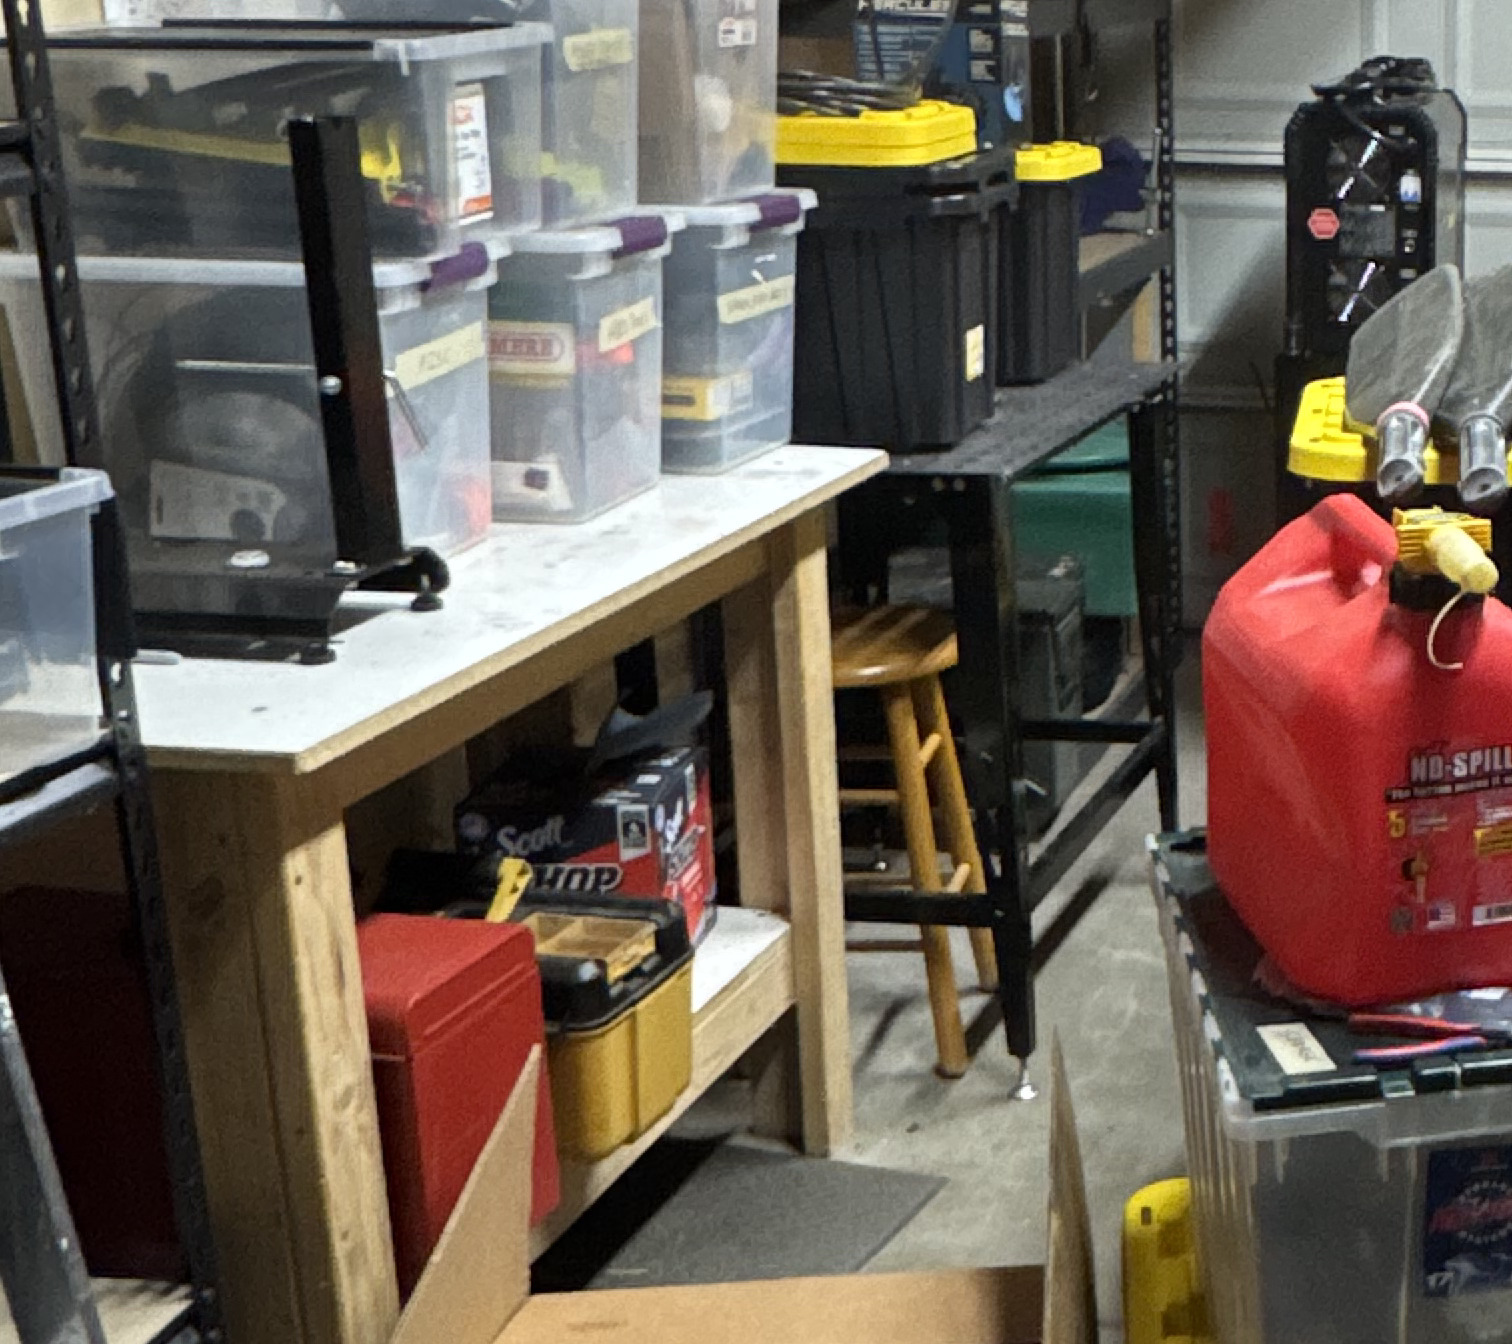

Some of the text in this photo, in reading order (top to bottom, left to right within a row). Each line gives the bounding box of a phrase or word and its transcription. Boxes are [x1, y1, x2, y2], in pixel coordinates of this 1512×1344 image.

[497, 814, 567, 858] Scott
[1387, 809, 1406, 838] 5
[533, 862, 621, 892] HOP
